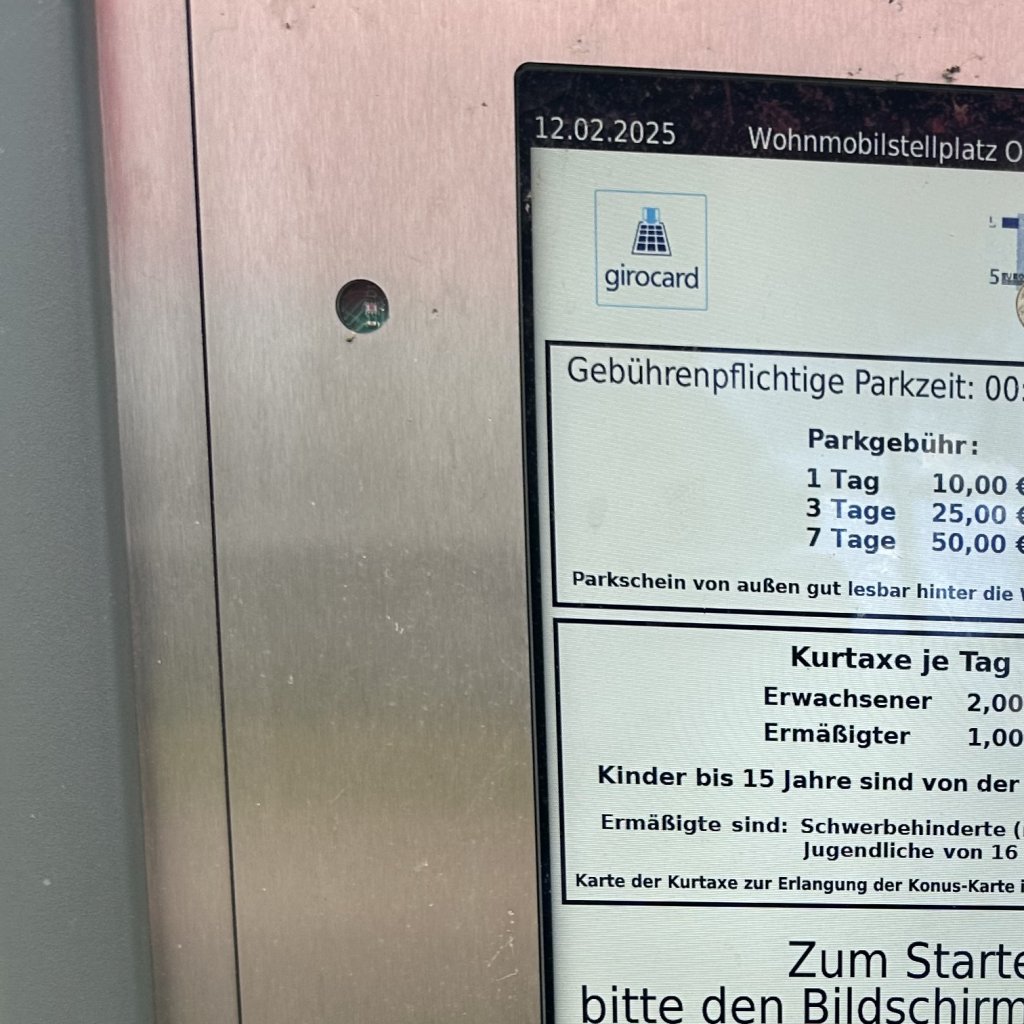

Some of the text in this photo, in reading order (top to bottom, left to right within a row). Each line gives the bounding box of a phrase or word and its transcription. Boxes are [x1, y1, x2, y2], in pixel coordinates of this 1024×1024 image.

[535, 115, 676, 145] 12.02.2025
[747, 125, 999, 163] Wohnmobilstellplatz
[604, 262, 699, 292] girocard
[989, 268, 1000, 285] 5
[567, 355, 845, 400] Gebührenpflichtige
[855, 368, 974, 400] Parkzeit:
[808, 428, 978, 457] Parkgebühr:
[807, 467, 822, 489] 1
[830, 468, 879, 496] Tag
[933, 472, 1008, 498] 10,00
[806, 497, 821, 518] 3
[830, 498, 896, 526] Tage
[932, 502, 1007, 527] 25,00
[806, 526, 821, 547] 7
[830, 527, 896, 555] Tage
[932, 531, 1007, 556] 50,00
[572, 570, 686, 590] Parkschein
[692, 578, 730, 592] von
[737, 577, 800, 595] außen
[806, 581, 842, 599] gut
[848, 580, 911, 599] lesbar
[916, 582, 978, 601] hinter
[983, 585, 1014, 602] die
[791, 645, 1011, 679] Kurtaxe je Tag
[764, 686, 933, 710] Erwachsener
[967, 692, 1024, 715] 2,00
[764, 722, 911, 749] Ermäßigter
[968, 727, 1024, 750] 1,00
[598, 764, 688, 786] Kinder
[696, 767, 734, 787] bis
[743, 768, 774, 788] 15
[781, 769, 852, 794] Jahre
[860, 771, 913, 791] sind
[921, 777, 968, 792] von
[976, 773, 1020, 793] der
[601, 813, 722, 836] Ermäßigte
[731, 815, 788, 834] sind:
[800, 817, 1006, 837] Schwerbehinderte
[802, 841, 935, 862] Jugendliche
[943, 847, 983, 860] von
[991, 844, 1018, 860] 16
[575, 873, 626, 888] Karte
[631, 873, 663, 889] der
[668, 874, 739, 890] Kurtaxe
[743, 878, 773, 890] zur
[778, 875, 868, 895] Erlangung
[873, 877, 903, 892] der
[908, 878, 1015, 894] Konus-Karte
[788, 940, 887, 979] Zum
[581, 984, 684, 1024] bitte
[701, 985, 783, 1024] den
